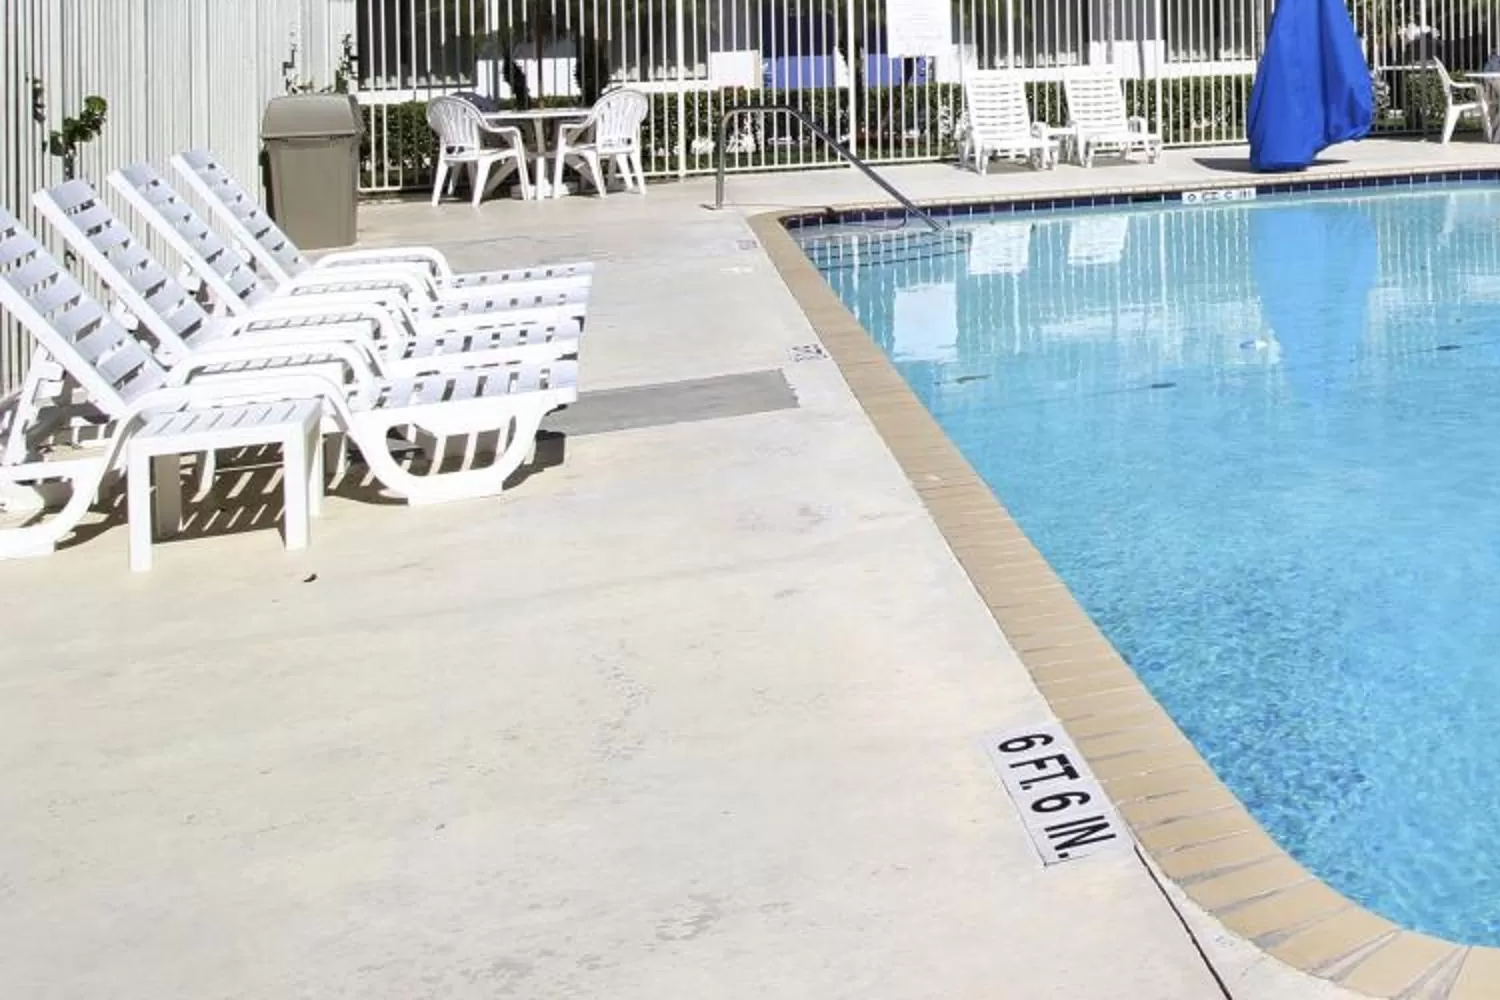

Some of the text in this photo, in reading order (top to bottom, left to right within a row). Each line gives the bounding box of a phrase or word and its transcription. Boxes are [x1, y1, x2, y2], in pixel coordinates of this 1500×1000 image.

[998, 733, 1117, 859] 6 FT. 6 IN.
